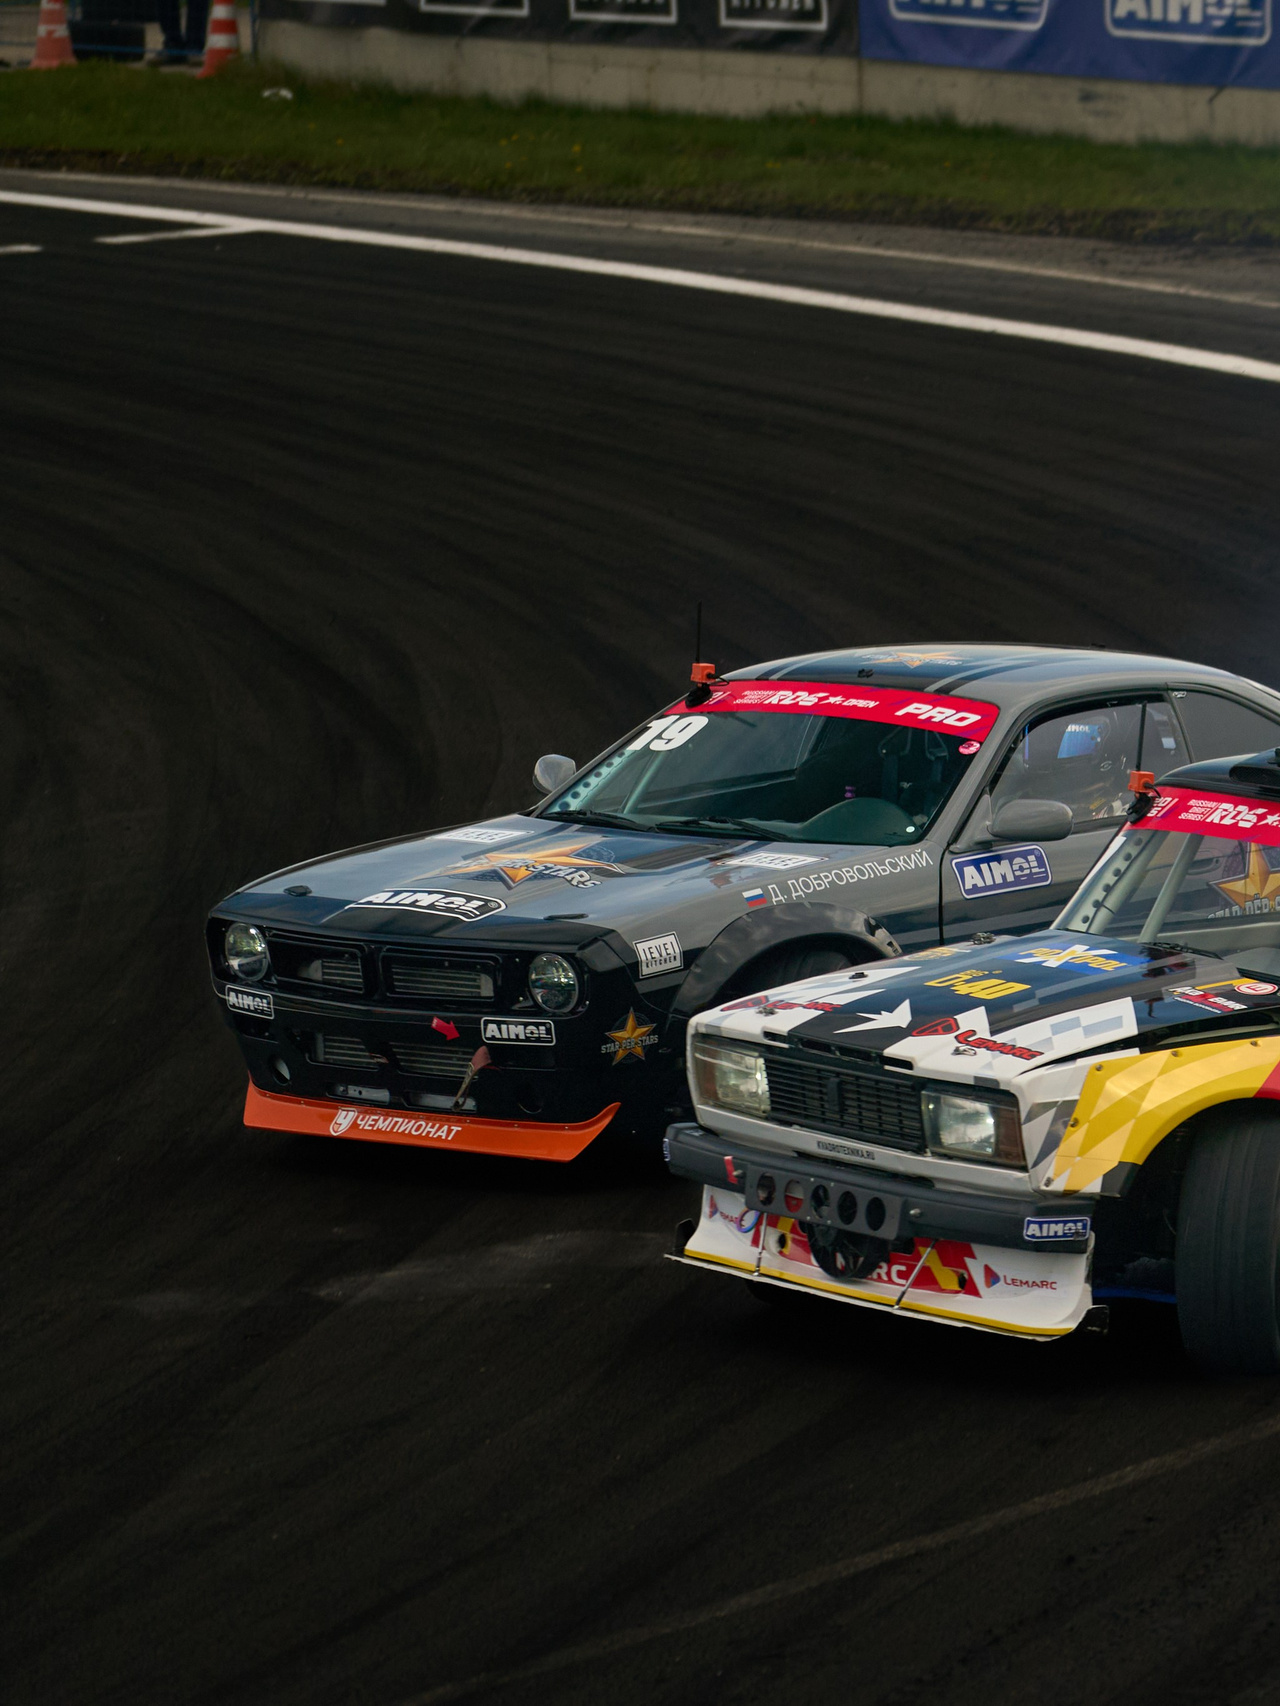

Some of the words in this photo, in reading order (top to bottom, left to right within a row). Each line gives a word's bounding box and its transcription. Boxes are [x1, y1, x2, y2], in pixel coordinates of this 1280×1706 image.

[840, 698, 880, 708] OPEN
[894, 703, 982, 727] PRO
[627, 714, 709, 751] 19
[1205, 803, 1268, 829] RDS
[767, 884, 788, 905] Д.
[787, 848, 934, 901] ДОБРОВОЛЬСКИЙ
[963, 854, 1047, 890] AIMOL
[357, 891, 486, 917] AIMOL
[645, 955, 678, 969] KITCHEN
[485, 1023, 552, 1041] AIMOL
[954, 1029, 1045, 1061] LEMARC
[600, 1041, 620, 1054] STAR
[356, 1114, 463, 1141] ЧЕМПИОНАТ
[1002, 1274, 1058, 1291] LEMARC
